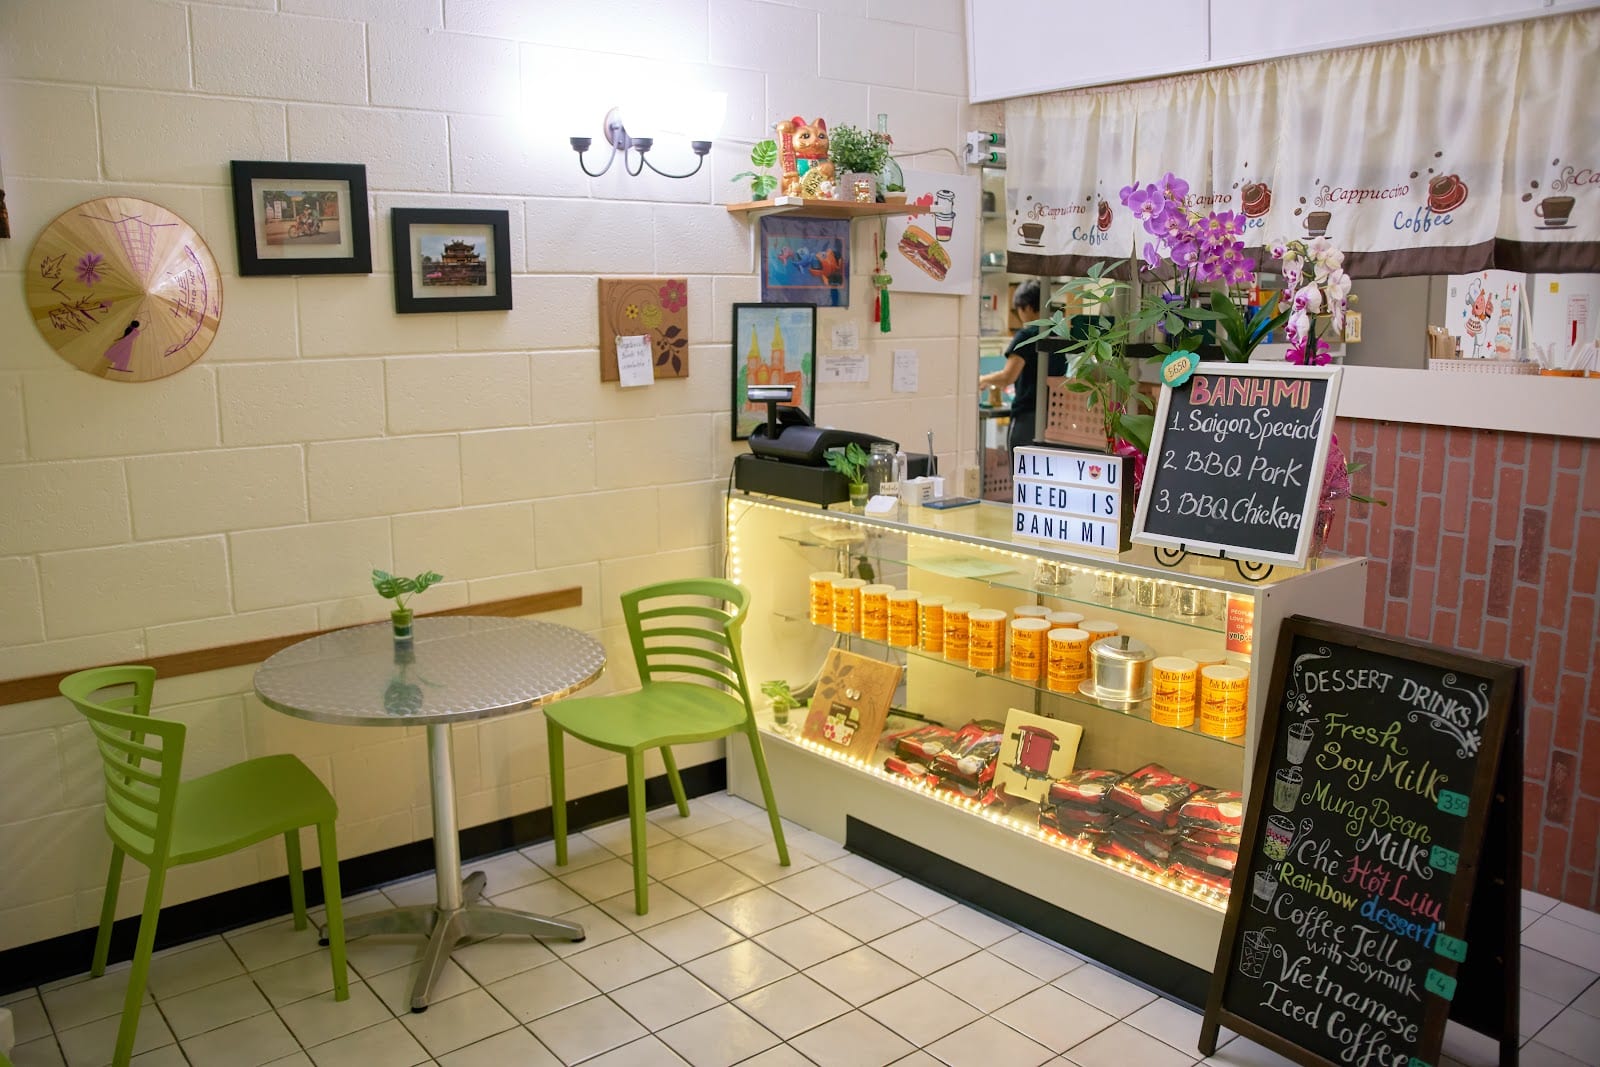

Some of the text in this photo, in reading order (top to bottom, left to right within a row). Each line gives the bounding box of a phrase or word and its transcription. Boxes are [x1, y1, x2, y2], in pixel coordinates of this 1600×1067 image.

[1393, 206, 1454, 233] Coffee
[1169, 407, 1323, 451] 1. Saigon Special
[1018, 454, 1055, 477] ALL
[1163, 450, 1303, 489] 2. BBQ Pork
[1018, 484, 1114, 516] NEED IS
[1155, 489, 1302, 532] 3. BBQ Chicken
[1016, 513, 1106, 546] BANH MI
[1304, 669, 1472, 728] DESSERT DRINKS
[1325, 712, 1408, 756] Fresh
[1315, 741, 1449, 803] Soy Milk
[1301, 780, 1432, 844] Mung Bean
[1297, 838, 1344, 876] Chè
[1355, 828, 1434, 880] Milk
[1273, 892, 1346, 940] Coffee
[1306, 939, 1342, 965] with
[1272, 943, 1419, 1042] Vietnamese
[1259, 981, 1409, 1067] Iced Coffee
